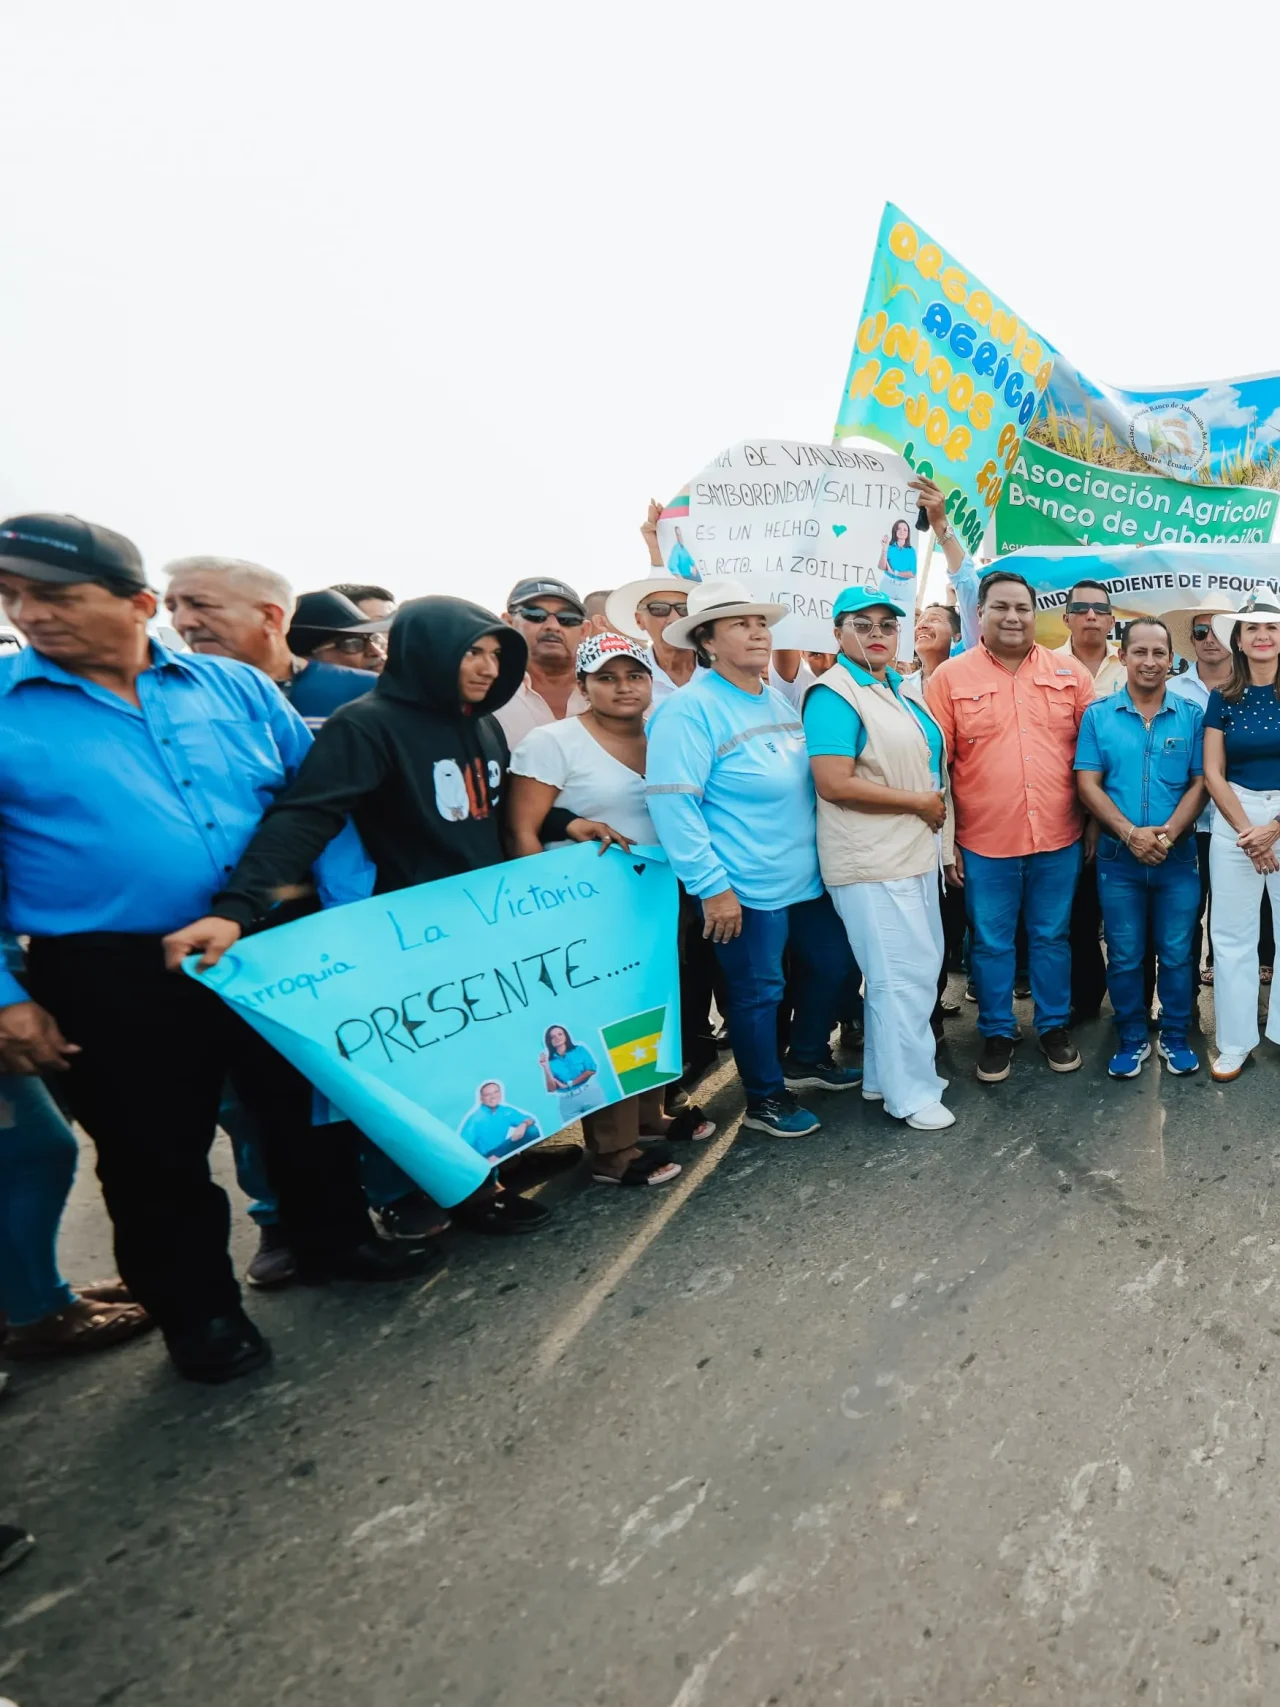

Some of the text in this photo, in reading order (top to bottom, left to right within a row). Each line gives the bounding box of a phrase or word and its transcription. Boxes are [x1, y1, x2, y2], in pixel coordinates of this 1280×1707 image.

[857, 311, 995, 431] UNIDOS
[744, 445, 776, 467] DE
[781, 445, 885, 472] VIALIDAD
[1008, 482, 1096, 527] Banco
[1102, 511, 1138, 537] de
[1011, 455, 1273, 525] Asociación Agricola
[696, 519, 821, 541] ES UN HECHO
[765, 556, 784, 573] LA
[790, 555, 878, 586] ZOILITA
[1037, 574, 1174, 610] INDNDIENTE
[1179, 574, 1202, 588] DE
[387, 909, 451, 953] La
[463, 875, 601, 927] Victoria
